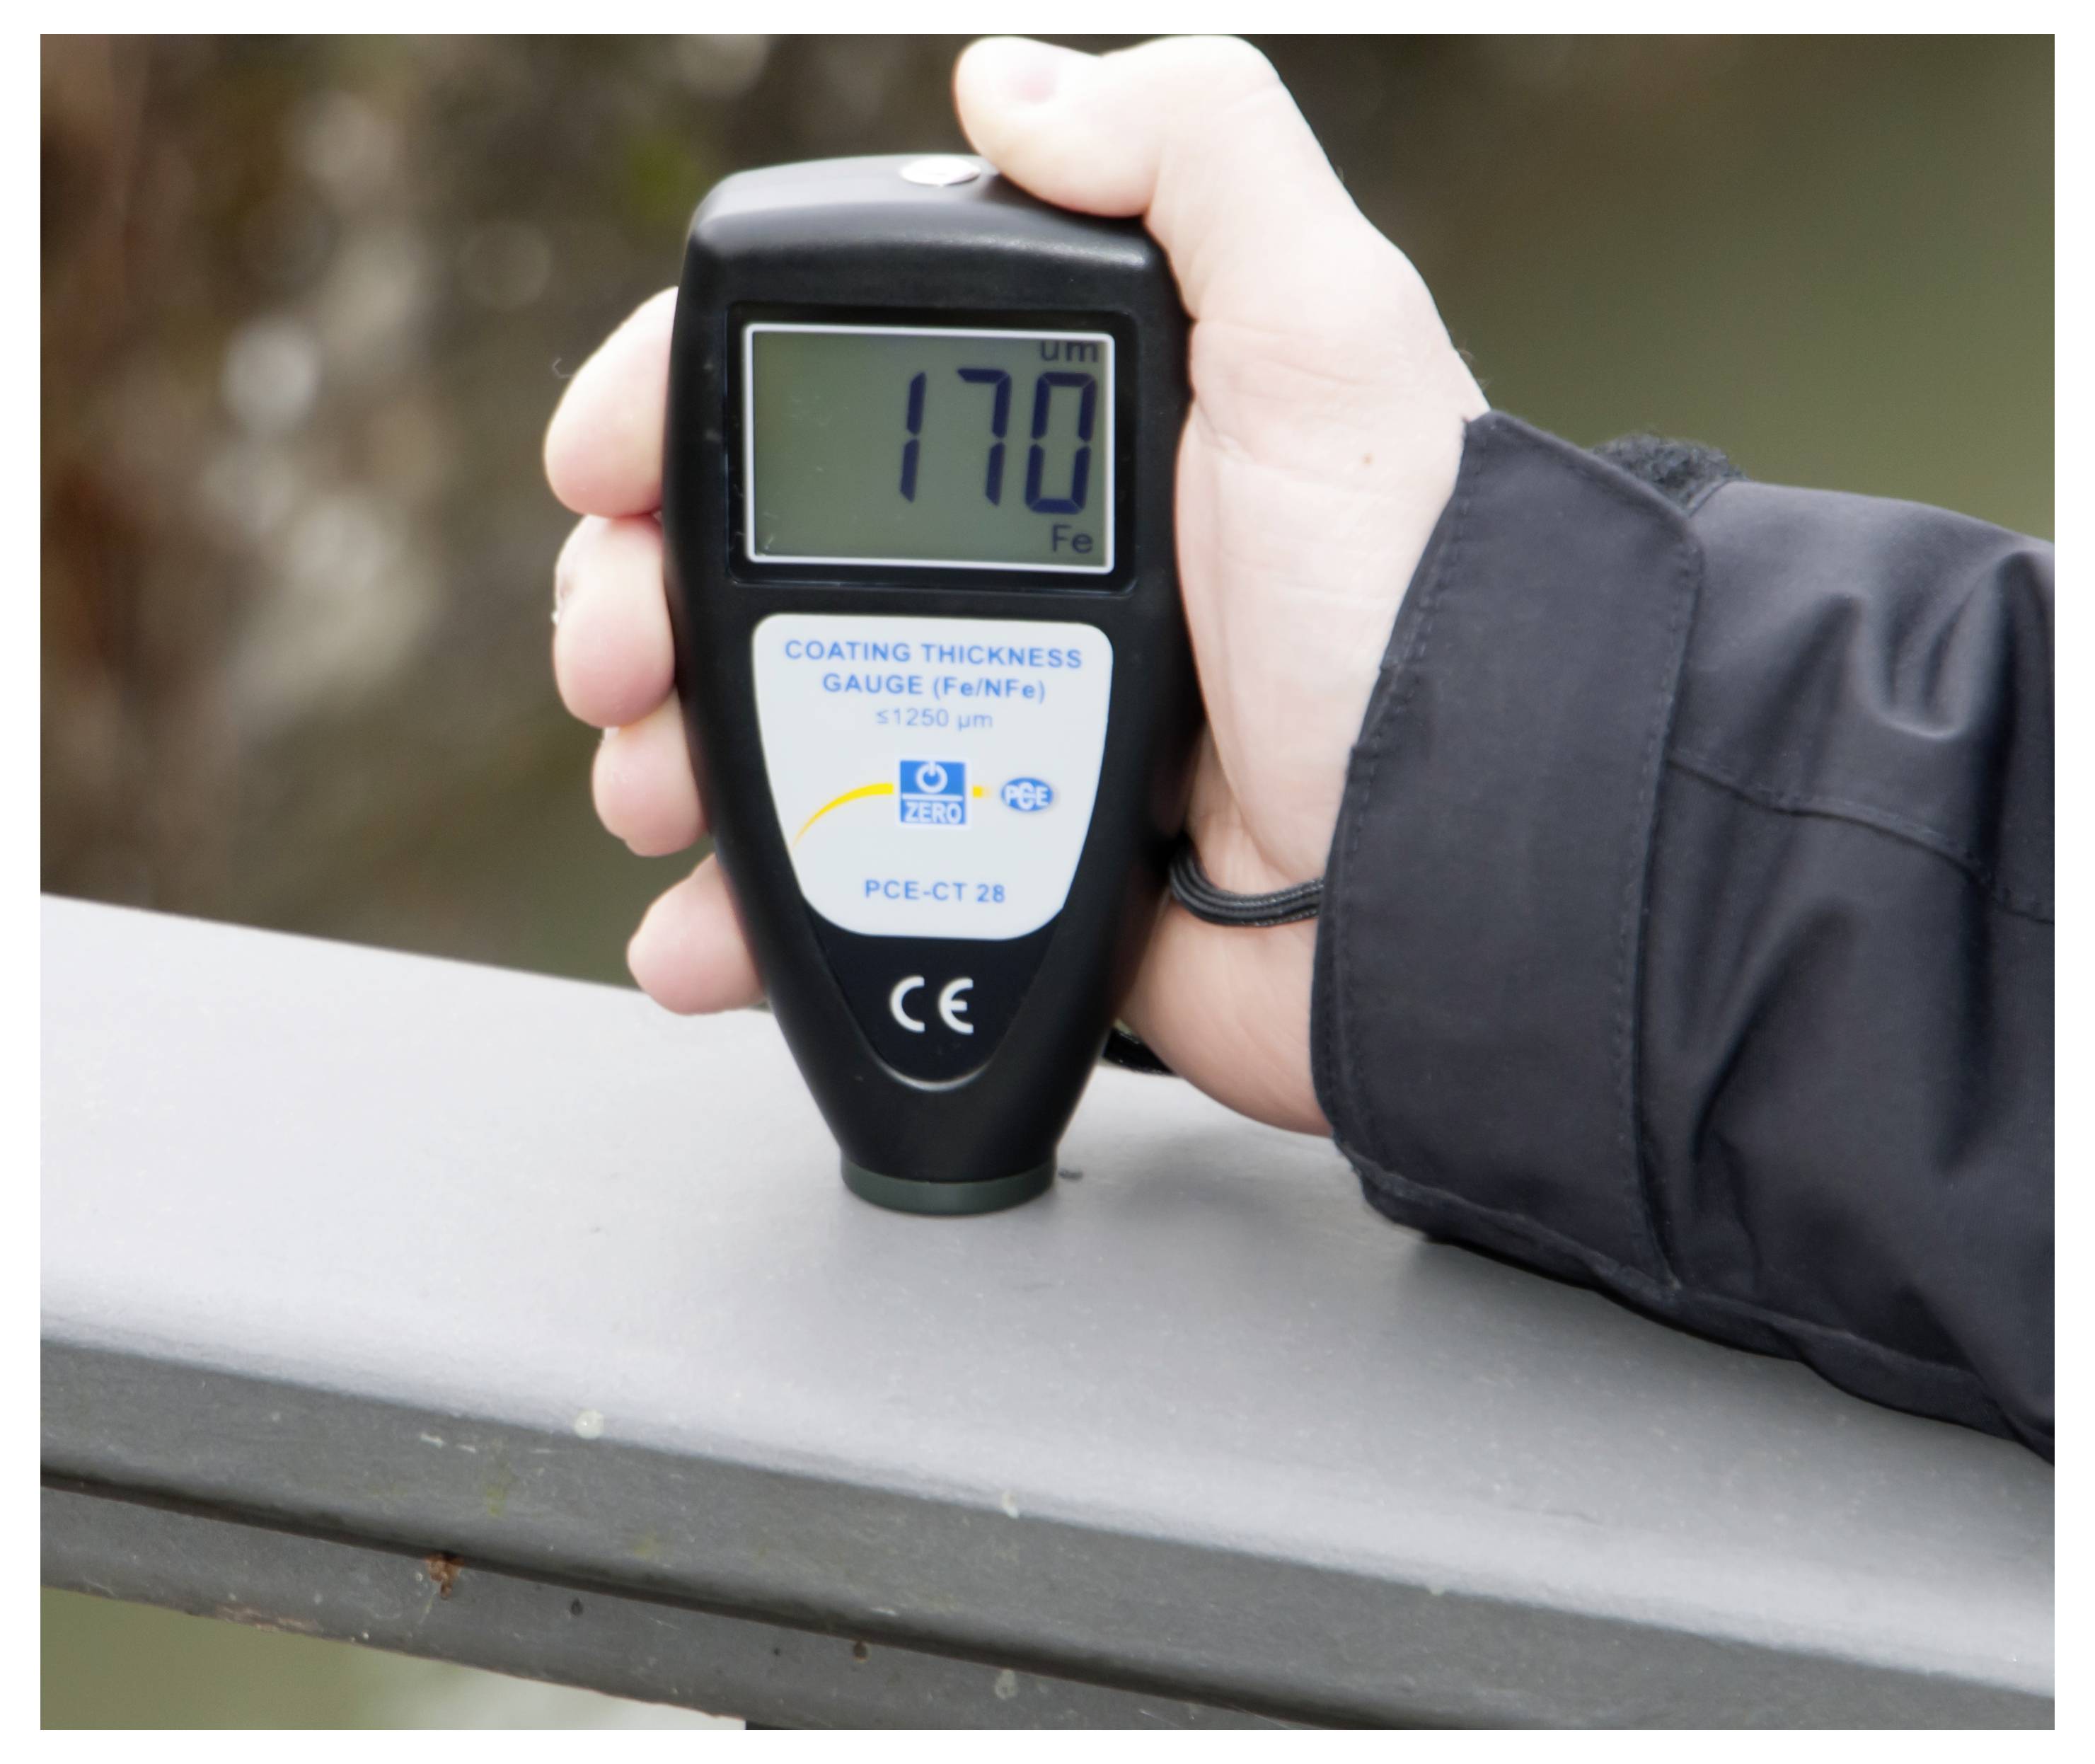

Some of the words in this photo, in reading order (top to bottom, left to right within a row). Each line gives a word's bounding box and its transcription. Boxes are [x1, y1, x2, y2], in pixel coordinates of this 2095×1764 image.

[900, 367, 1097, 514] 170
[1051, 523, 1094, 555] Fe
[785, 640, 911, 663] COATING
[921, 643, 1083, 669] THICKNESS
[822, 673, 924, 695] GAUGE
[933, 676, 1046, 703] (Fe/NFe)
[1004, 781, 1050, 811] PCE
[904, 802, 963, 824] ZERO
[864, 879, 968, 903] PCE-CT
[976, 883, 1005, 904] 28
